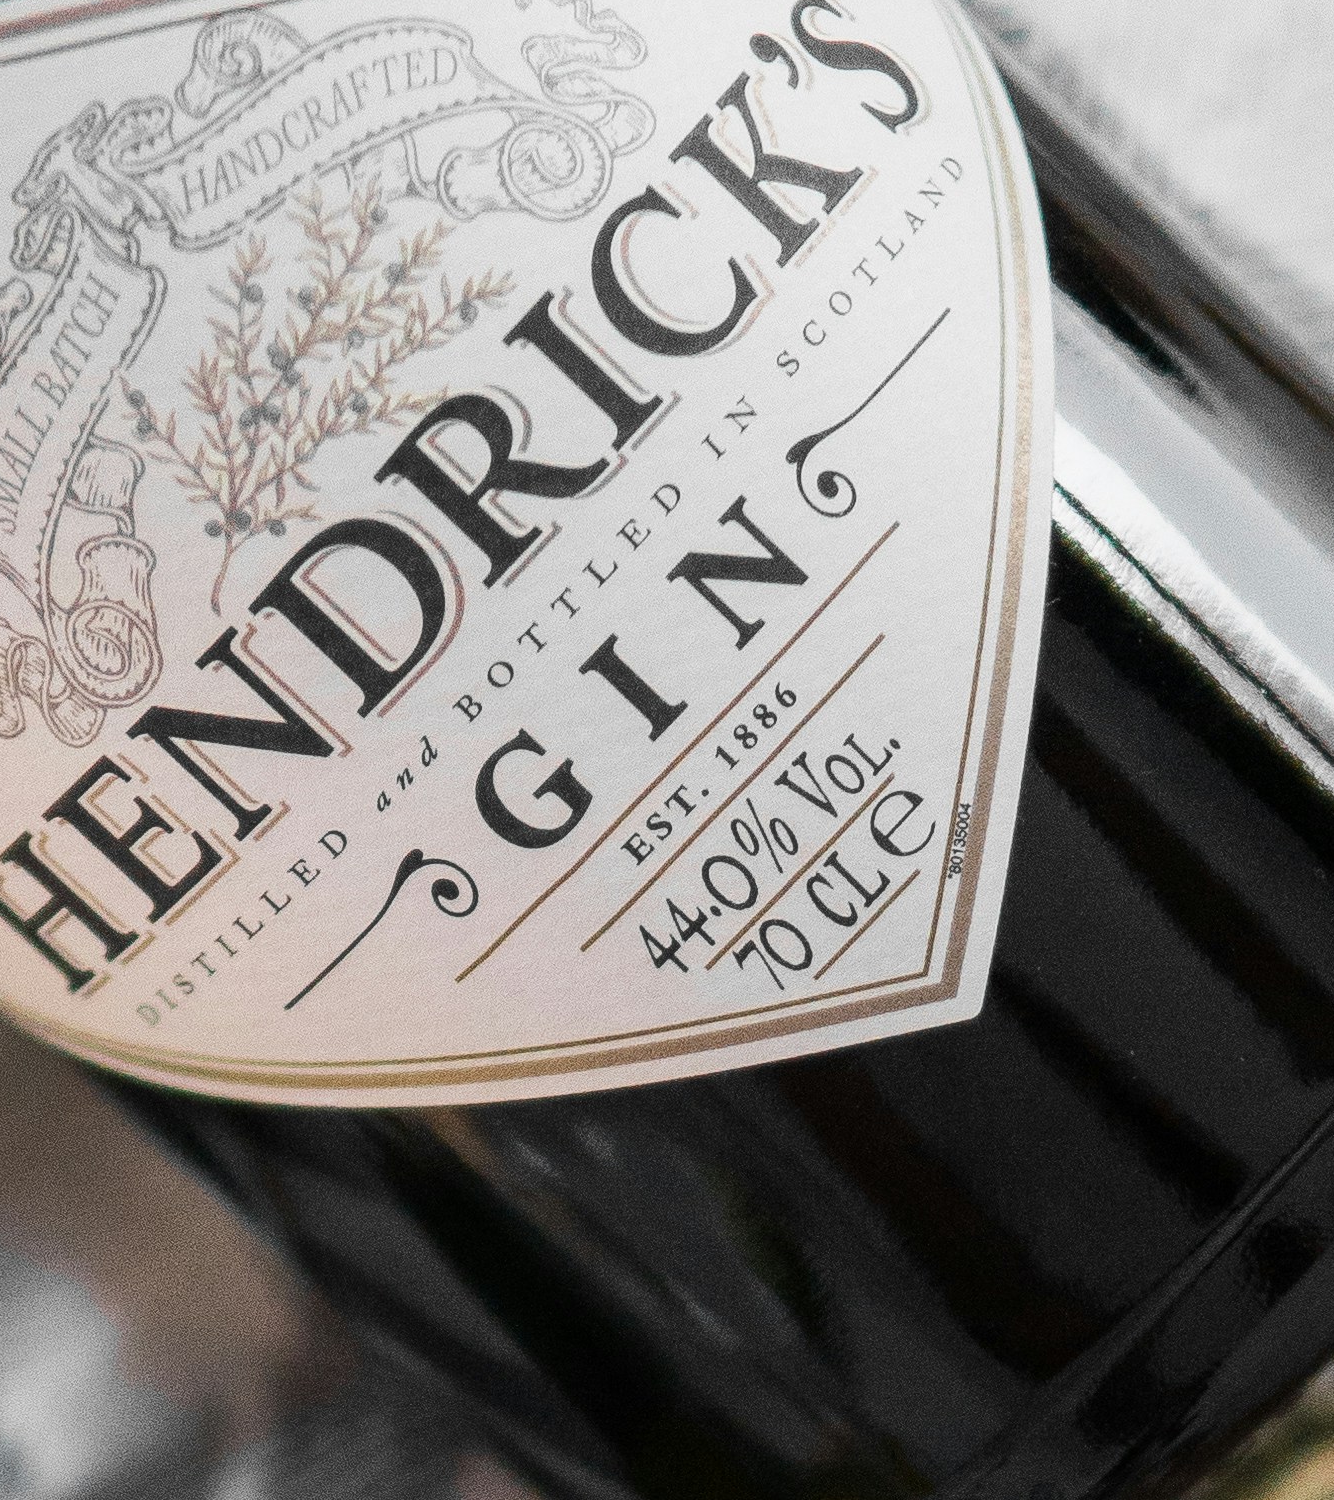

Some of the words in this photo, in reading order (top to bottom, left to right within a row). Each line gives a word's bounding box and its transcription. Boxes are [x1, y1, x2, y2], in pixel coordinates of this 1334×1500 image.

[178, 46, 459, 215] HANDCRAFTED
[31, 271, 120, 398] BATCH
[135, 829, 349, 1027] DISTILLED
[376, 735, 439, 813] and
[452, 482, 682, 723] BOTTLED
[701, 394, 758, 460] IN
[775, 155, 964, 378] SCOTLAND
[474, 494, 810, 850] GIN
[620, 783, 710, 866] EST.
[715, 681, 797, 770] 1886
[639, 797, 799, 973] 44.0%
[732, 918, 814, 991] 70
